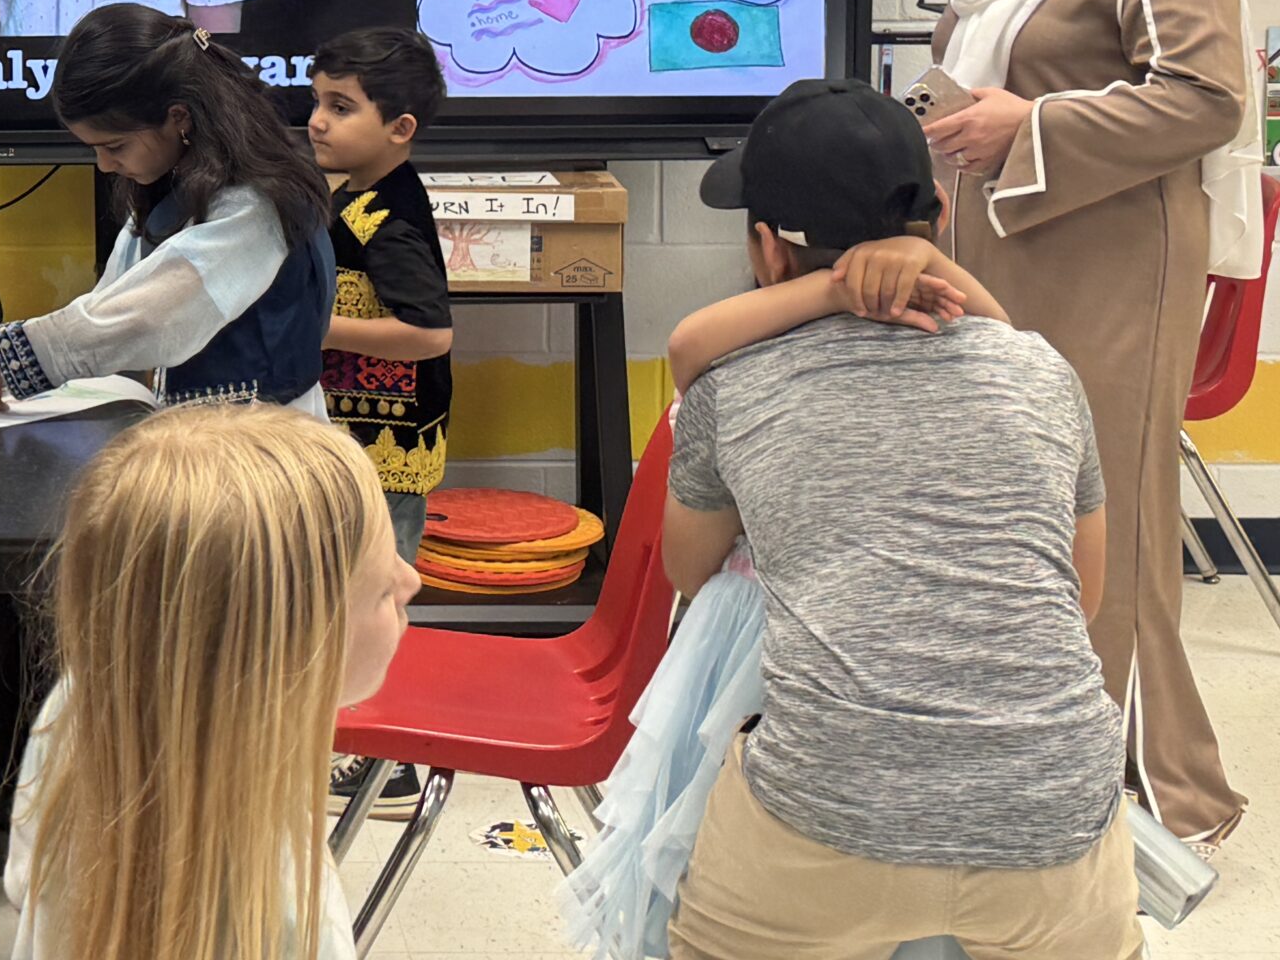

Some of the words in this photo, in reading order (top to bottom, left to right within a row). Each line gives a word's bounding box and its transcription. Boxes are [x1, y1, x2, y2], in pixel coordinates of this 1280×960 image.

[477, 9, 519, 26] home
[485, 198, 505, 213] It
[521, 196, 560, 217] In!
[565, 275, 578, 284] 25
